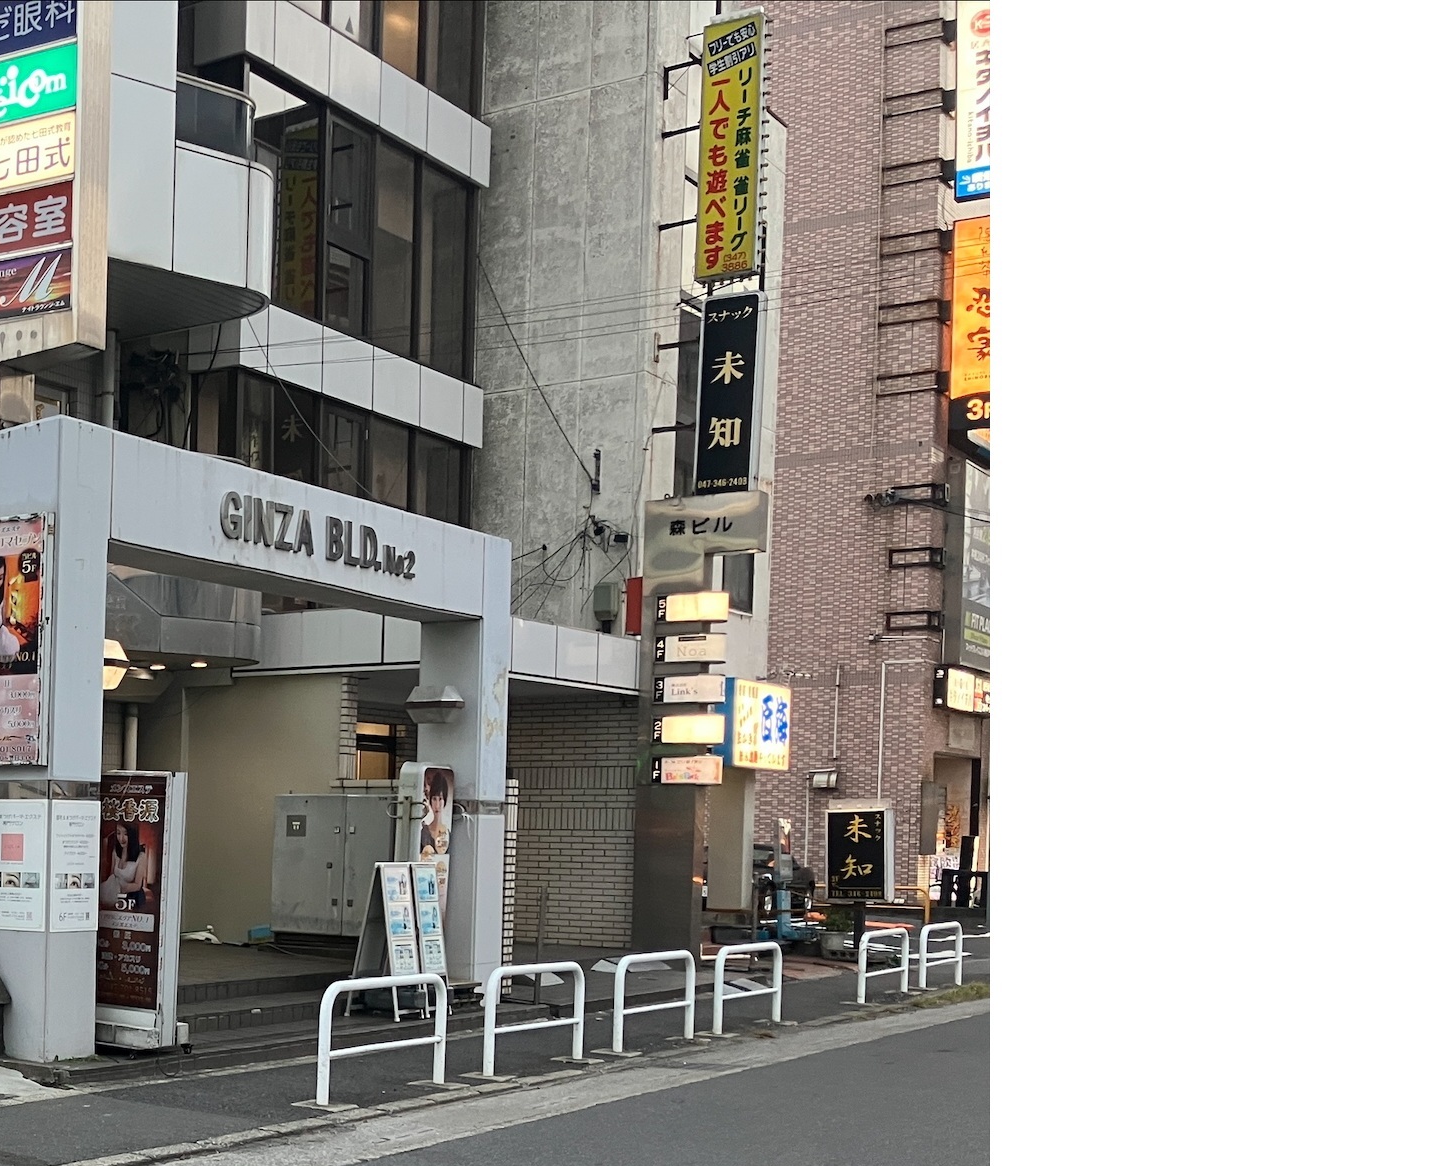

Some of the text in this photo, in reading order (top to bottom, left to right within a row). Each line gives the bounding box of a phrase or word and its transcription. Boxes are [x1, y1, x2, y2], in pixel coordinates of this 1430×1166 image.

[709, 24, 756, 55] フリーでも安心
[709, 43, 754, 75] 学生割引アリ
[731, 67, 753, 252] リーチ麻雀 雀リーグ
[704, 79, 731, 270] 一人でも遊べます
[723, 252, 747, 262] (347)
[0, 254, 62, 307] M
[708, 306, 753, 324] スナック
[707, 351, 745, 450] 未知
[220, 491, 314, 556] GINZA
[669, 516, 733, 537] 森ビル
[22, 560, 36, 574] 5F
[657, 599, 666, 617] 5F
[656, 640, 664, 658] 4F
[676, 645, 707, 657] Noa
[655, 680, 663, 699] 3F
[671, 687, 698, 696] Link's
[653, 721, 662, 739] 2F
[652, 760, 660, 779] 1F
[874, 813, 882, 842] スナック
[840, 814, 873, 880] 未知
[115, 893, 136, 911] 5F
[59, 912, 66, 921] 6F
